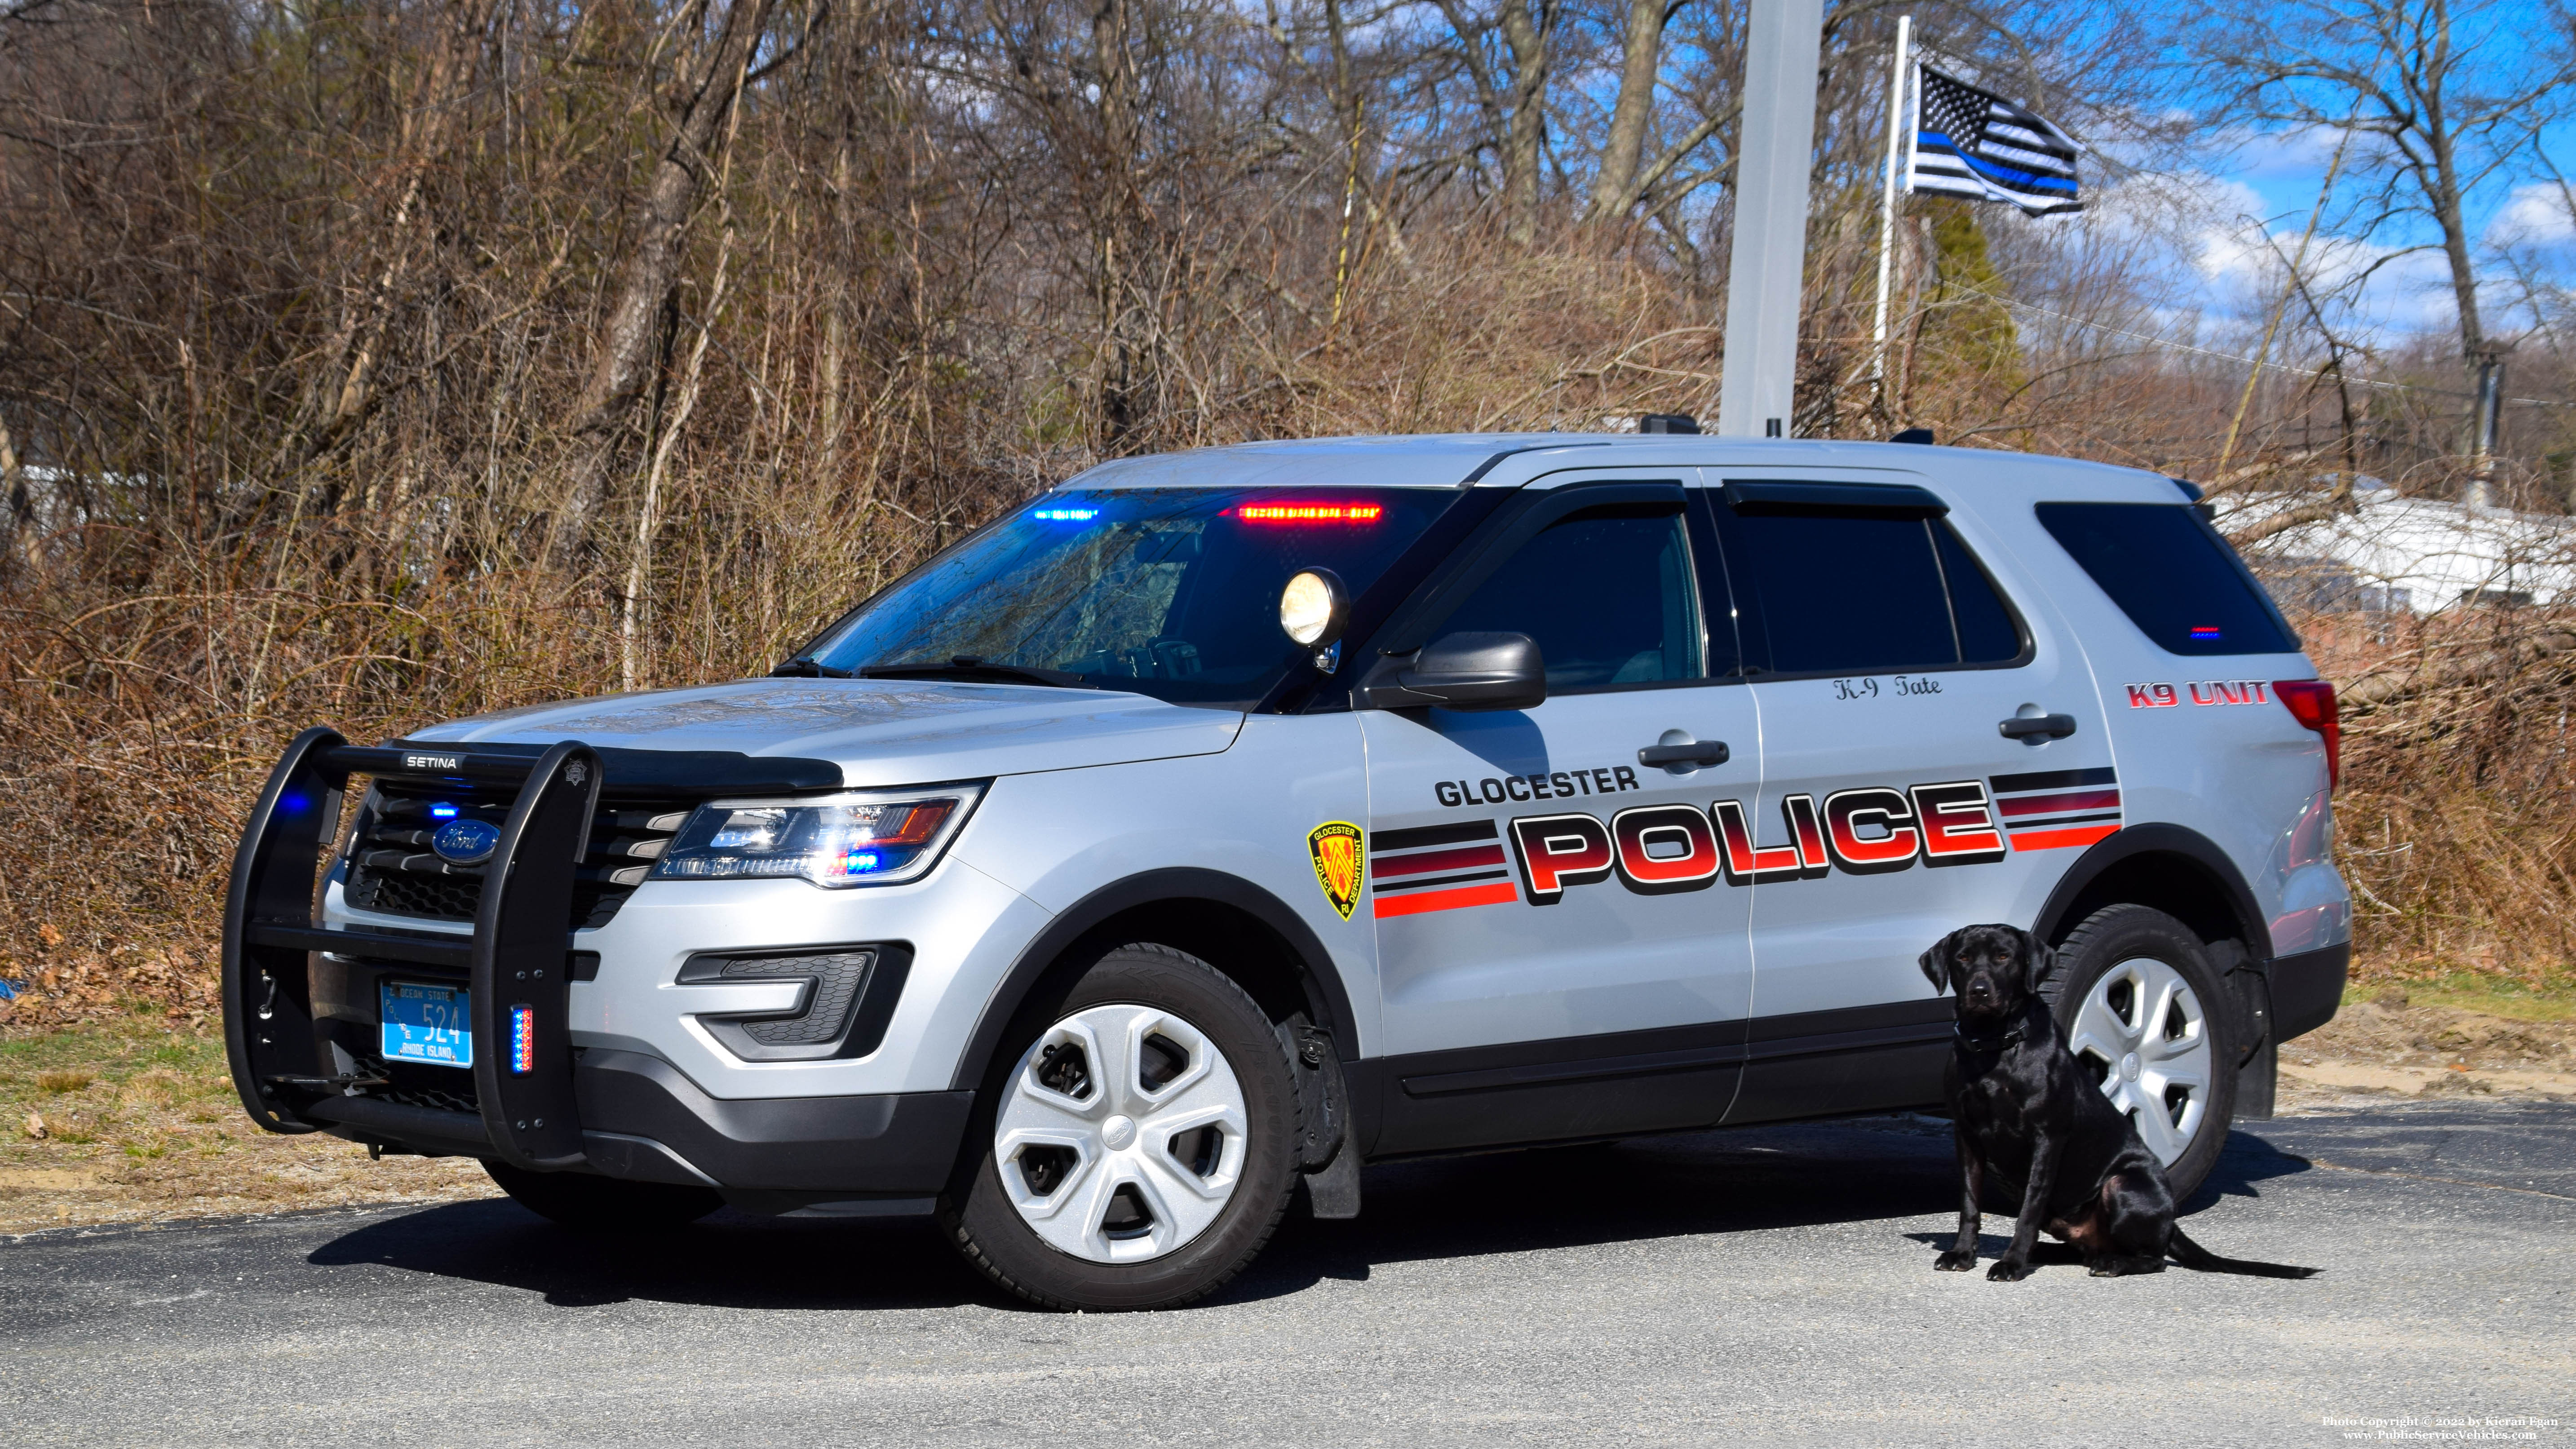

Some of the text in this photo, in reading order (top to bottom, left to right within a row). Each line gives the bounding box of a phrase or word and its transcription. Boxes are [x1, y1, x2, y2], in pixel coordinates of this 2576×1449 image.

[1833, 676, 1943, 700] K-9 Tate
[2124, 679, 2269, 709] K9 UNIT
[407, 756, 456, 769] SETINA
[1434, 766, 1640, 807] GLOCESTER
[441, 829, 483, 850] Ford
[1314, 826, 1355, 841] GLOCESTER
[1507, 780, 2005, 906] POLICE
[1315, 856, 1334, 895] POLICE
[1349, 838, 1362, 904] DEPARTMENT
[1341, 904, 1349, 913] RI
[400, 988, 451, 1002] OCEAN STATE
[423, 1003, 459, 1045] 524
[403, 1042, 452, 1059] RHODE ISLAND
